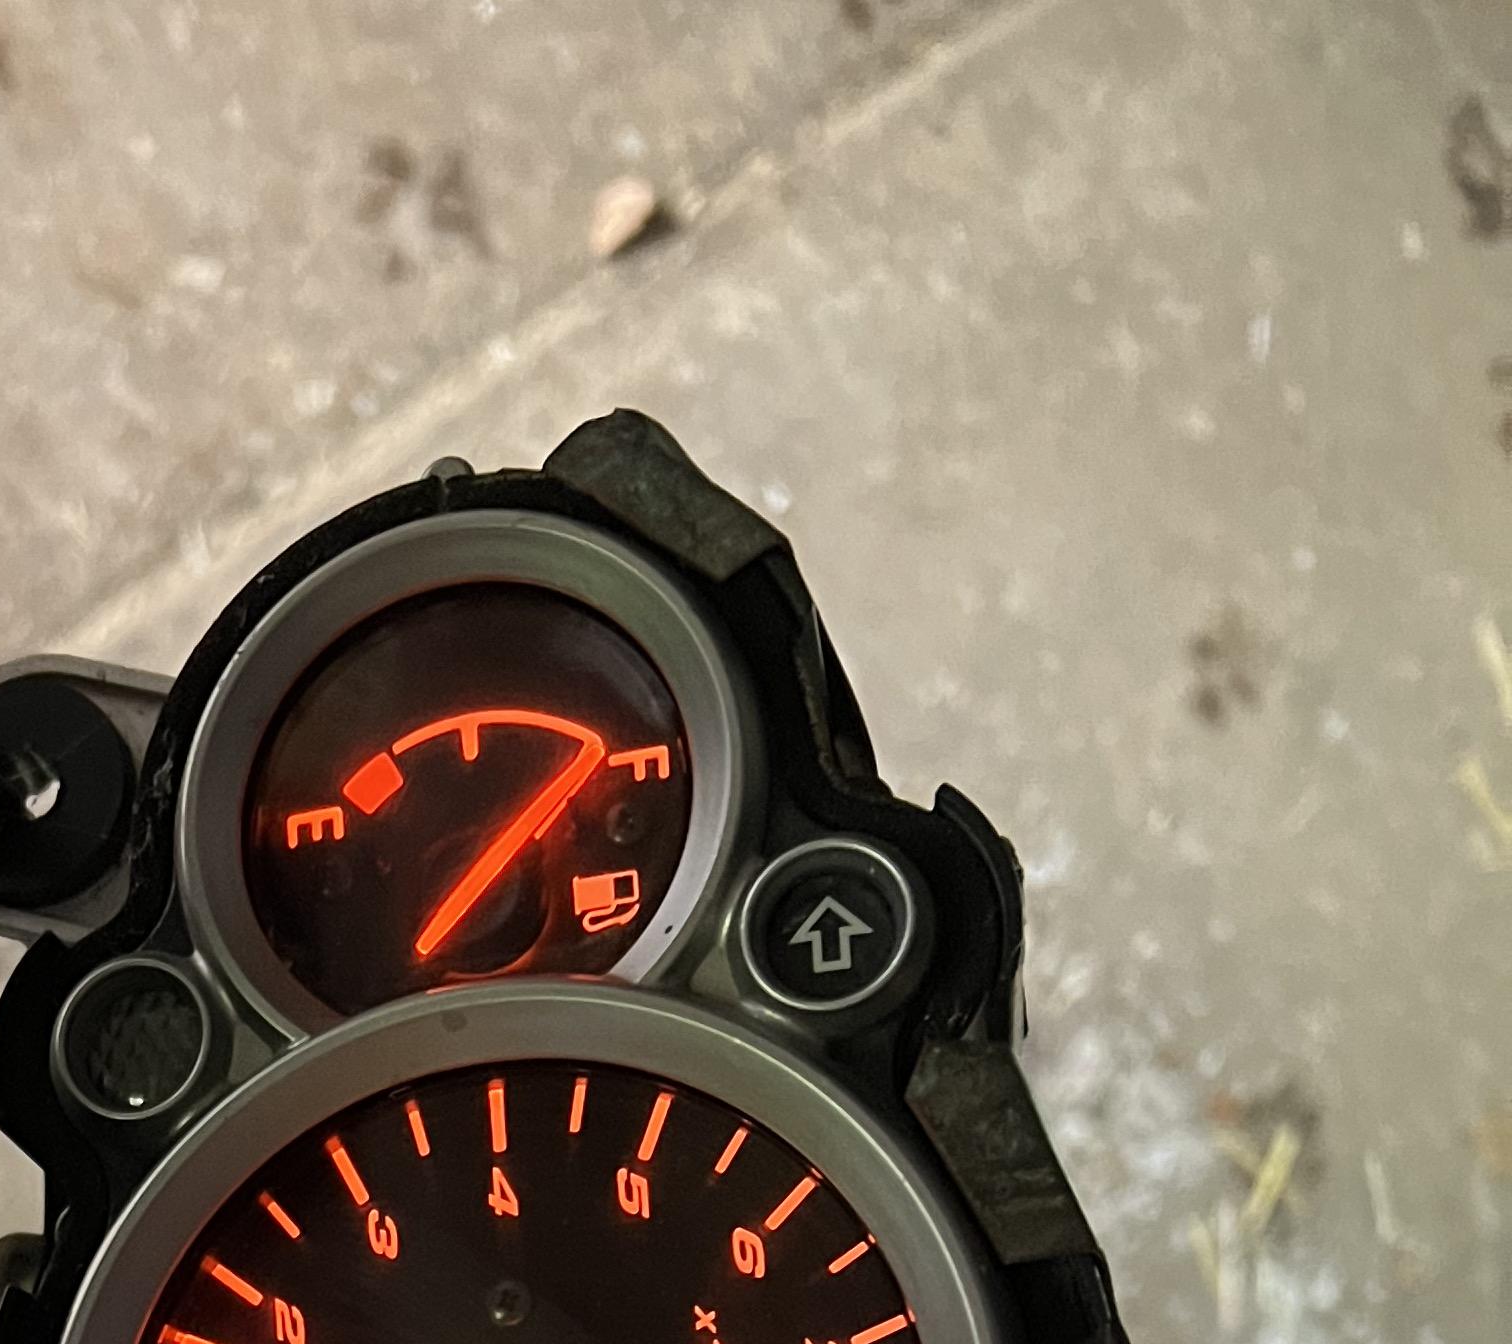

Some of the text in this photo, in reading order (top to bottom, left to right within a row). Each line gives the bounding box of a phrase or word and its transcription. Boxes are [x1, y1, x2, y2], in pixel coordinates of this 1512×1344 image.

[607, 744, 670, 782] F
[286, 805, 345, 849] E
[487, 1166, 519, 1217] 4
[616, 1167, 650, 1219] 5
[367, 1208, 399, 1260] 3
[731, 1226, 766, 1279] 6
